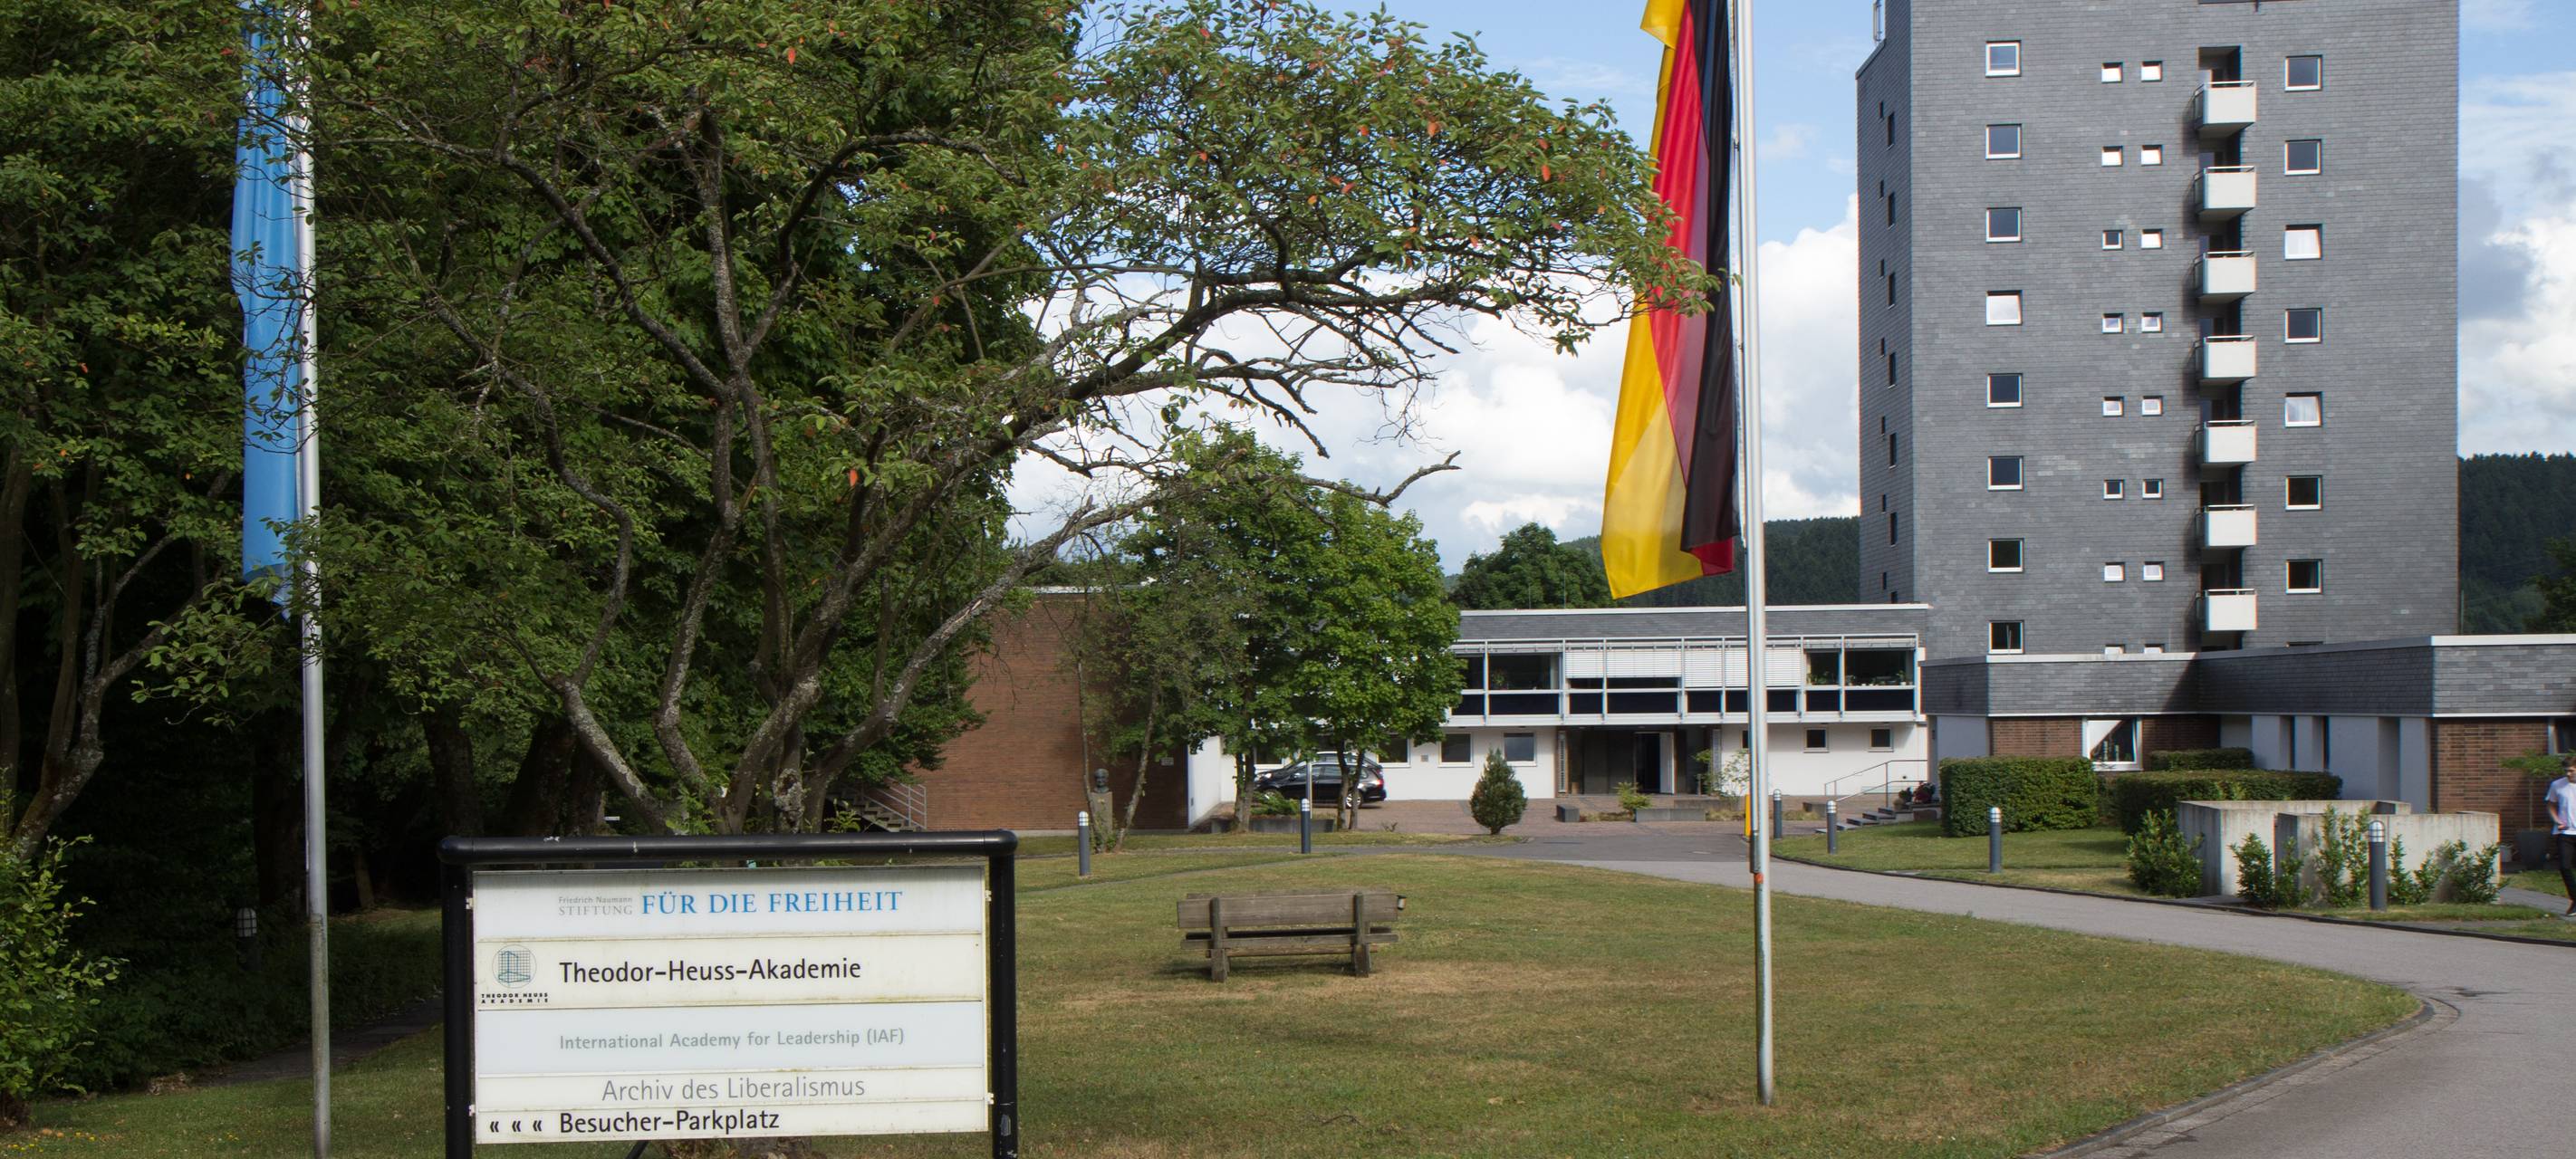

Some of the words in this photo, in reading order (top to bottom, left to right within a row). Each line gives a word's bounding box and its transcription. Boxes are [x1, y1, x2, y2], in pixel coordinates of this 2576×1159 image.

[558, 896, 593, 904] Friedrich
[595, 896, 633, 904] Naumann
[558, 905, 633, 916] STIFTUNG
[641, 891, 697, 915] FÜR
[708, 893, 757, 914] DIE
[769, 891, 903, 913] FREIHEIT
[559, 957, 861, 984] Theodor-Heuss-Akademie
[559, 1033, 663, 1049] International
[669, 1032, 741, 1049] Academy
[747, 1031, 771, 1046] for
[778, 1030, 860, 1048] Leadership
[866, 1028, 905, 1047] (IAF)
[601, 1078, 674, 1102] Archiv
[681, 1078, 719, 1100] des
[728, 1076, 865, 1099] Liberalismus
[560, 1109, 780, 1135] Besucher-Parkplatz
